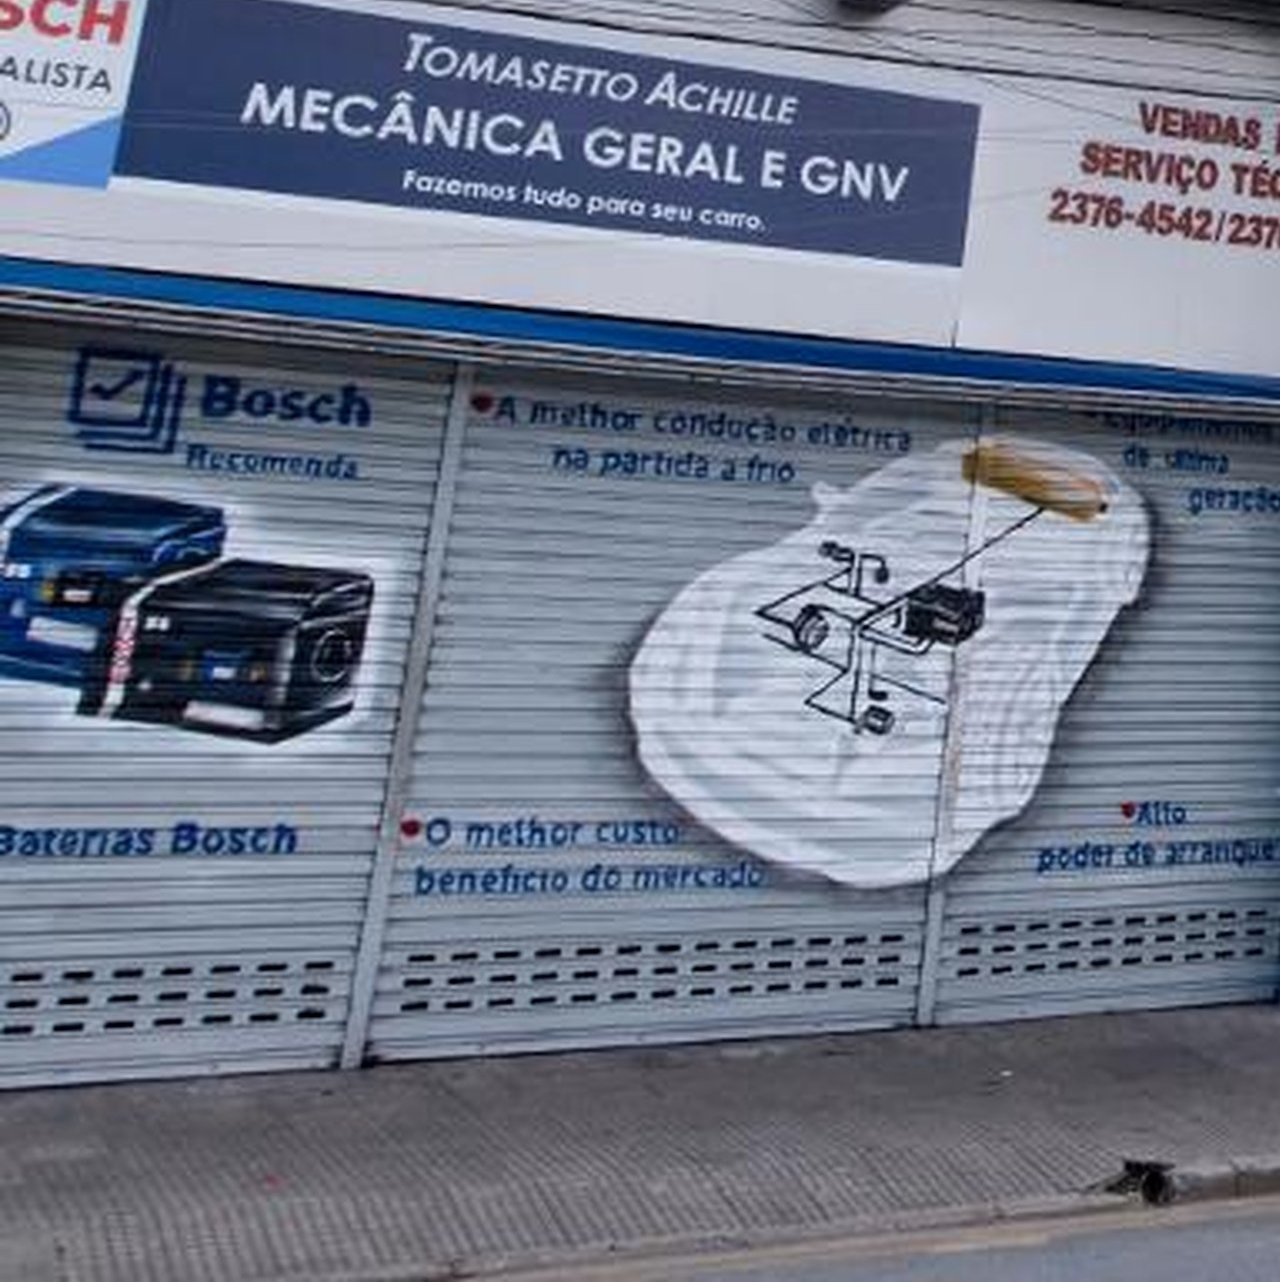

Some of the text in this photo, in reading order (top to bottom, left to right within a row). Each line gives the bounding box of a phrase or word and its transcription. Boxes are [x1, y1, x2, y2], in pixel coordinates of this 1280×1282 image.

[402, 33, 799, 125] TOMASETTO ACHILLE
[240, 82, 909, 203] MECÂNICA GERAL E GNV
[1138, 100, 1262, 151] VENDAS
[1079, 141, 1219, 195] SERVIÇO
[402, 170, 767, 232] Fazemos tudo para seu carro.
[201, 374, 373, 428] Bosch
[497, 395, 912, 453] A melhor condução elétrica
[185, 442, 361, 480] Recomenda
[552, 447, 797, 484] na partida a frio
[426, 815, 681, 849] O melhor custo
[1137, 801, 1187, 826] Alto
[169, 822, 297, 856] Bosch
[1036, 838, 1279, 872] poder de arranque
[580, 863, 621, 890] do
[632, 860, 765, 889] mercado
